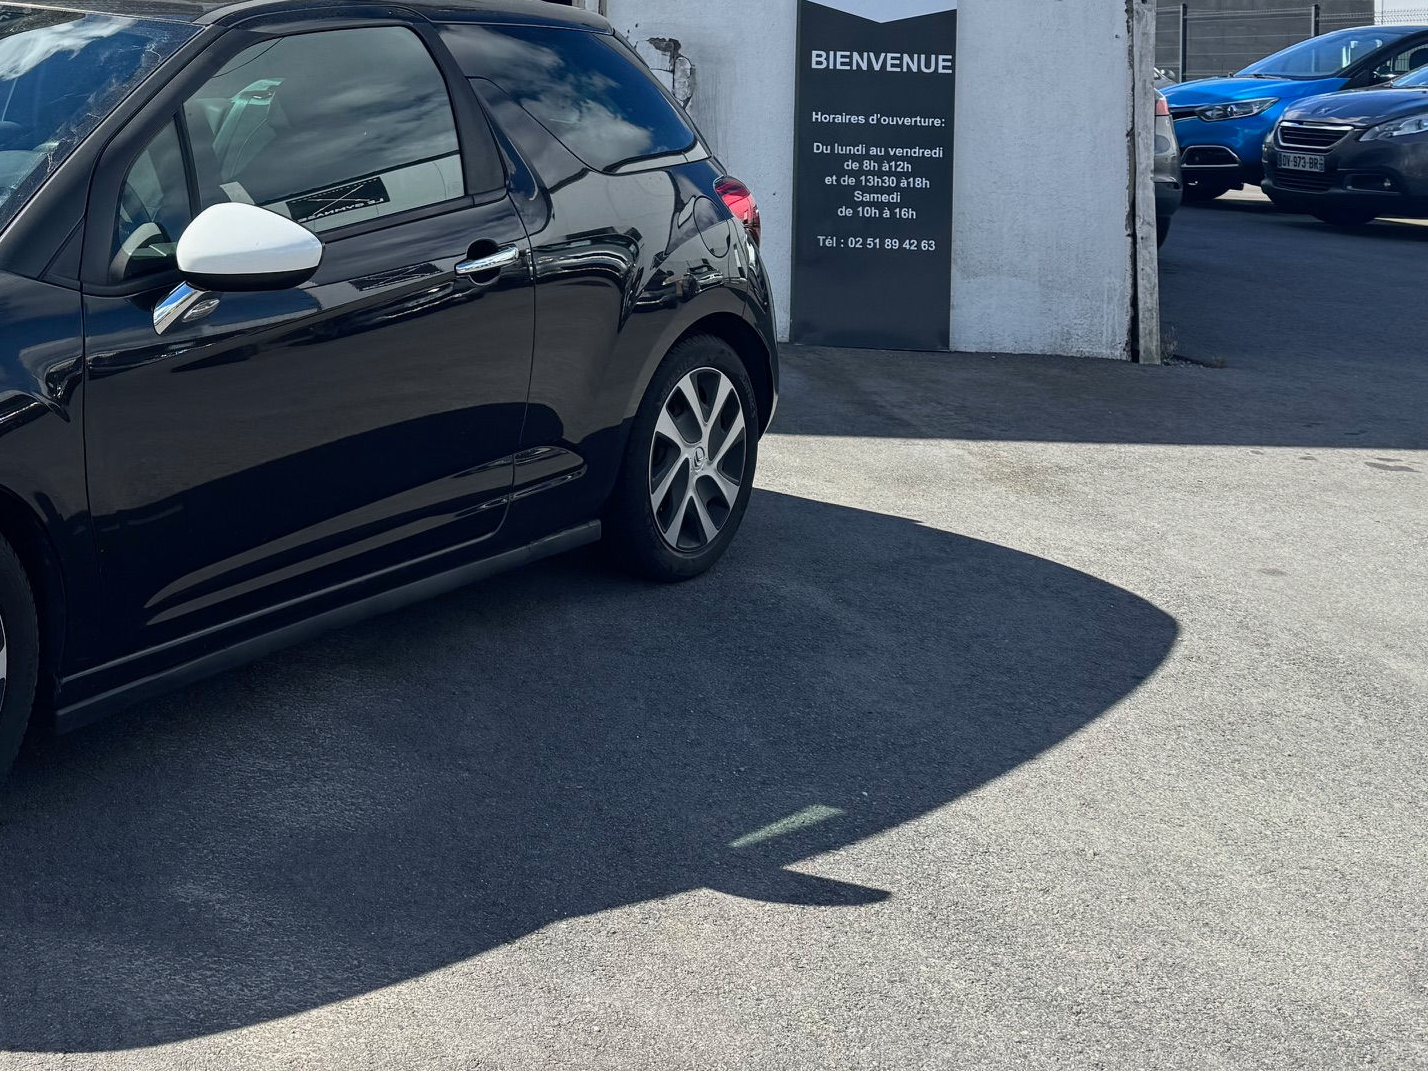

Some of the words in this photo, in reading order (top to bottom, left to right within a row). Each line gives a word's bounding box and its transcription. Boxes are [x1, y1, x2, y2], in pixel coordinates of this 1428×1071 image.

[812, 51, 952, 73] BIENVENUE
[813, 112, 865, 123] Horaires
[814, 143, 830, 153] Du
[835, 143, 865, 154] lundi
[870, 147, 884, 155] au
[889, 147, 943, 157] vendredi
[844, 159, 859, 170] de
[863, 160, 878, 170] 8h
[825, 175, 837, 184] et
[841, 175, 855, 185] de
[860, 176, 896, 187] 13h30
[854, 191, 900, 202] Samedi
[838, 206, 853, 216] de
[857, 207, 878, 217] 10h
[883, 207, 890, 217] à
[895, 208, 916, 219] 16h
[817, 236, 836, 247] Tél
[848, 237, 862, 247] 02
[867, 238, 879, 248] 51
[885, 239, 899, 249] 89
[903, 240, 917, 250] 42
[921, 240, 935, 250] 63
